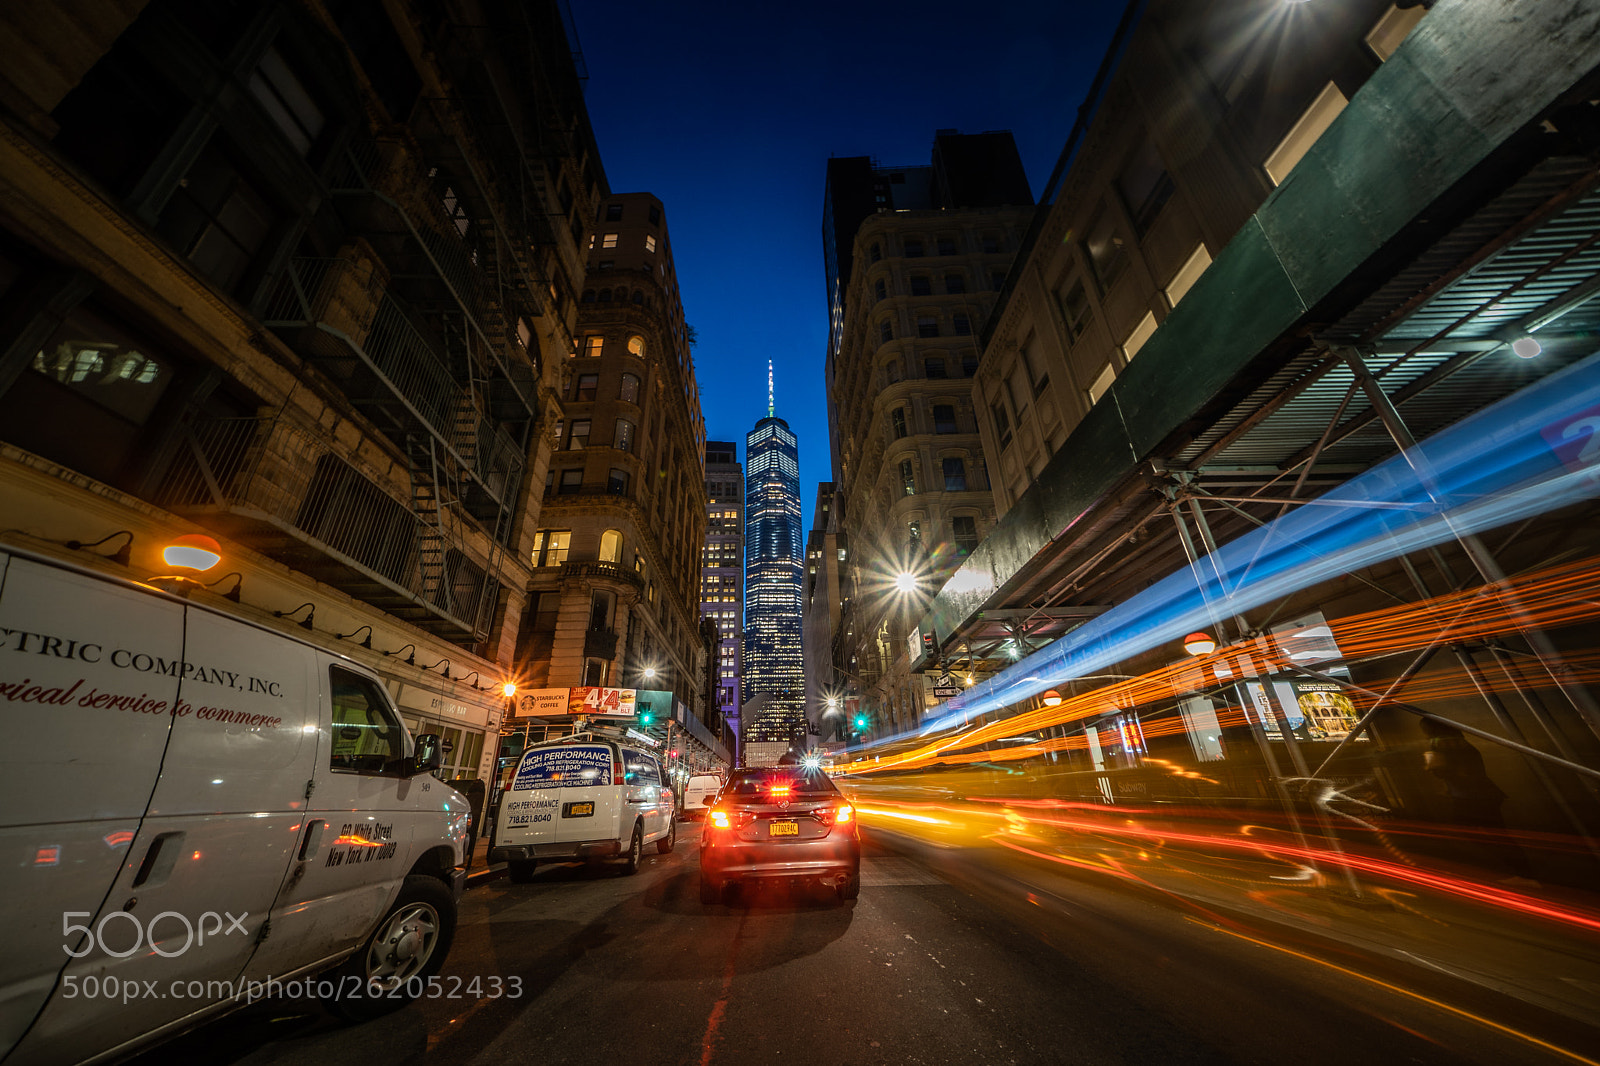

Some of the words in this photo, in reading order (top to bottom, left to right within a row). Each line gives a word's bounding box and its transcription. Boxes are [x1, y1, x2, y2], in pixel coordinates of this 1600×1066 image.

[0, 627, 102, 664] TRIC
[110, 649, 243, 692] COMPANY,
[248, 677, 284, 698] INC.
[78, 688, 167, 716] service
[170, 698, 193, 718] to
[196, 706, 282, 729] commerce
[523, 755, 543, 767] HIGH
[544, 751, 611, 762] PERFORMANCE
[521, 763, 543, 773] COOLING
[545, 764, 581, 772] 718.821.8040
[507, 801, 520, 810] HIGH
[520, 799, 559, 809] PERFORMANCE
[508, 813, 552, 824] 718.821.8040
[353, 823, 372, 840] White
[373, 822, 393, 840] Street
[325, 847, 345, 868] New
[364, 846, 377, 862] NY
